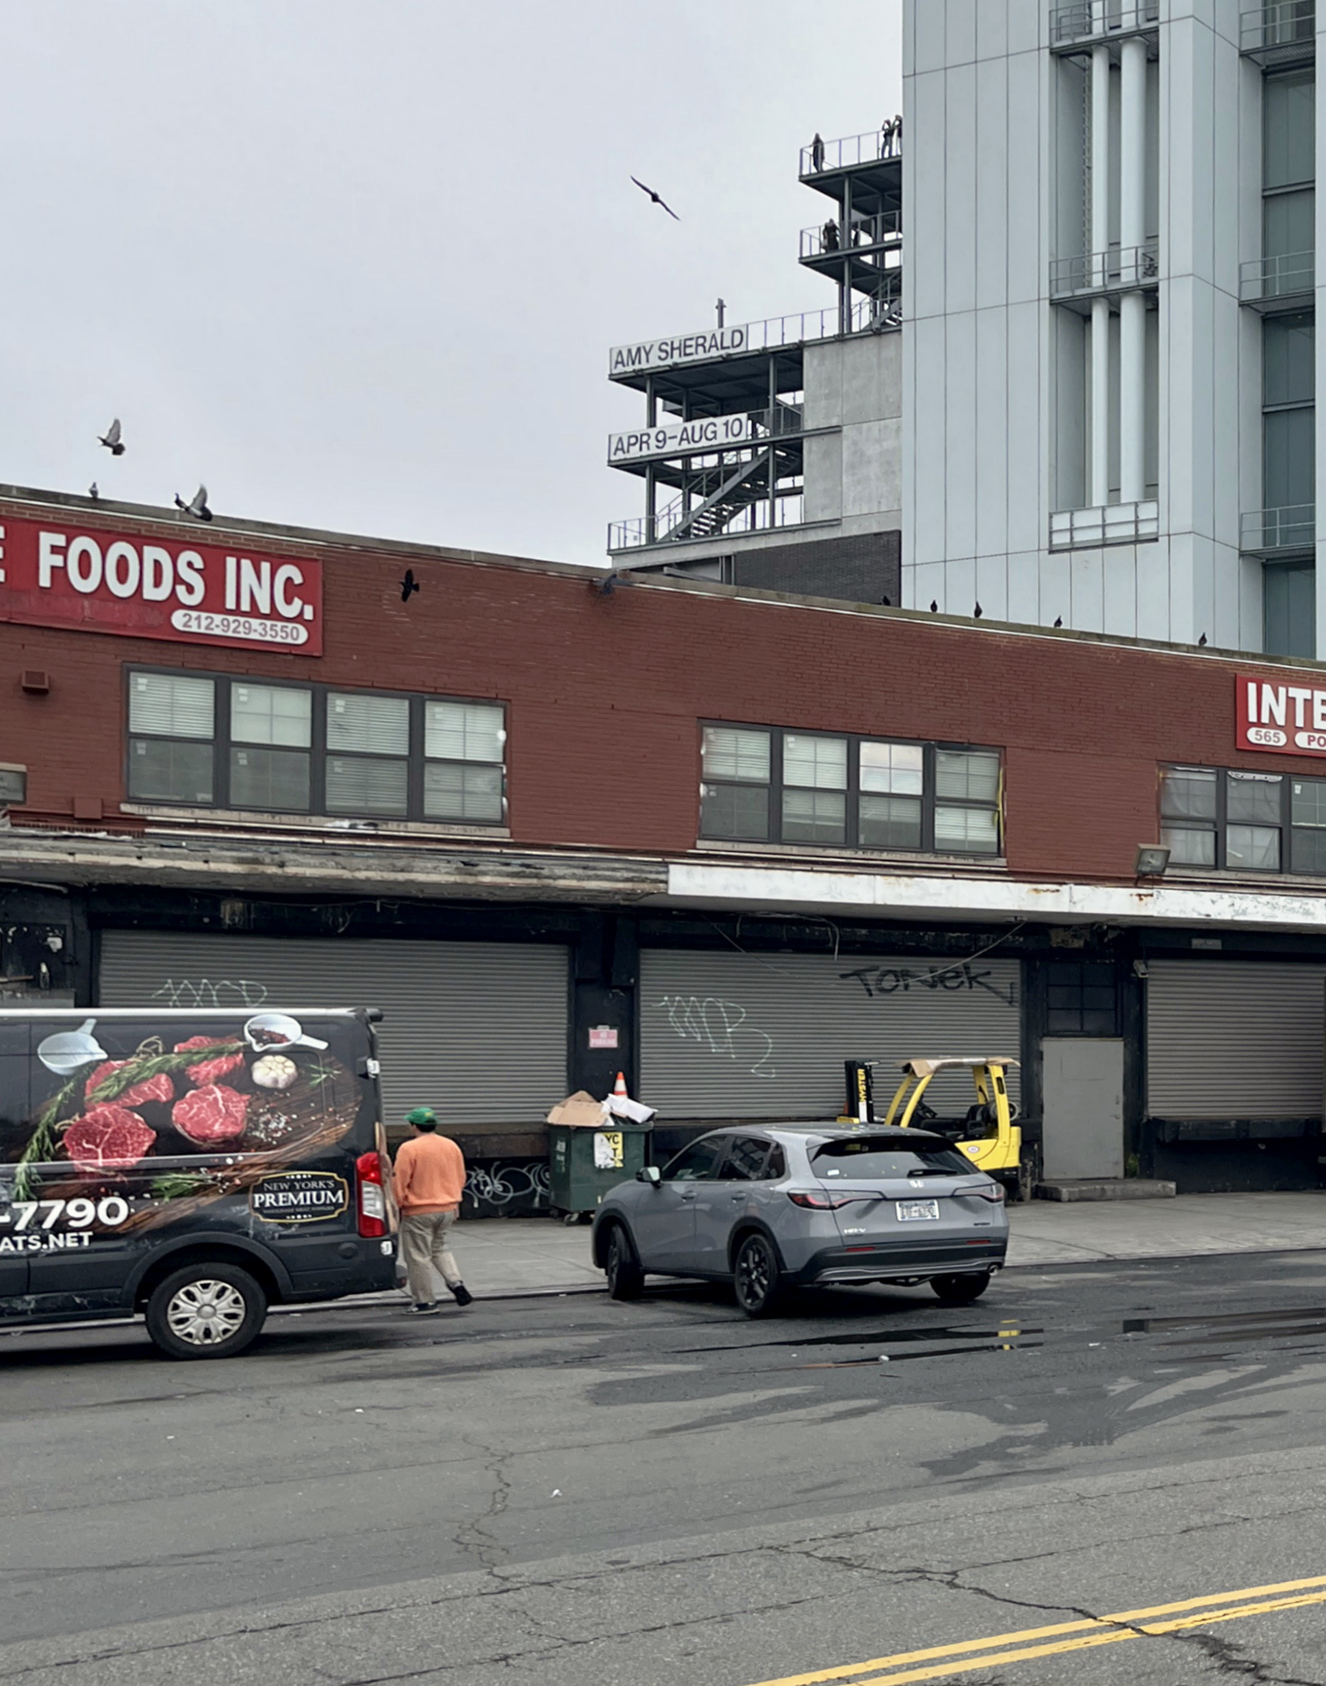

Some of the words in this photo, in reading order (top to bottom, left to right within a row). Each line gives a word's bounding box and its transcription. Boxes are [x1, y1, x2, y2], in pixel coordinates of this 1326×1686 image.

[613, 343, 654, 370] AMY
[657, 328, 744, 361] SHERALD
[613, 432, 651, 456] APR
[722, 417, 744, 439] 10
[38, 530, 206, 607] FOODS
[224, 555, 315, 621] INC.
[181, 612, 301, 642] 212-929-3550
[1254, 729, 1281, 744] 565
[253, 1189, 344, 1208] PREMIUM
[263, 1181, 291, 1191] NEW
[294, 1179, 335, 1190] YORK'S
